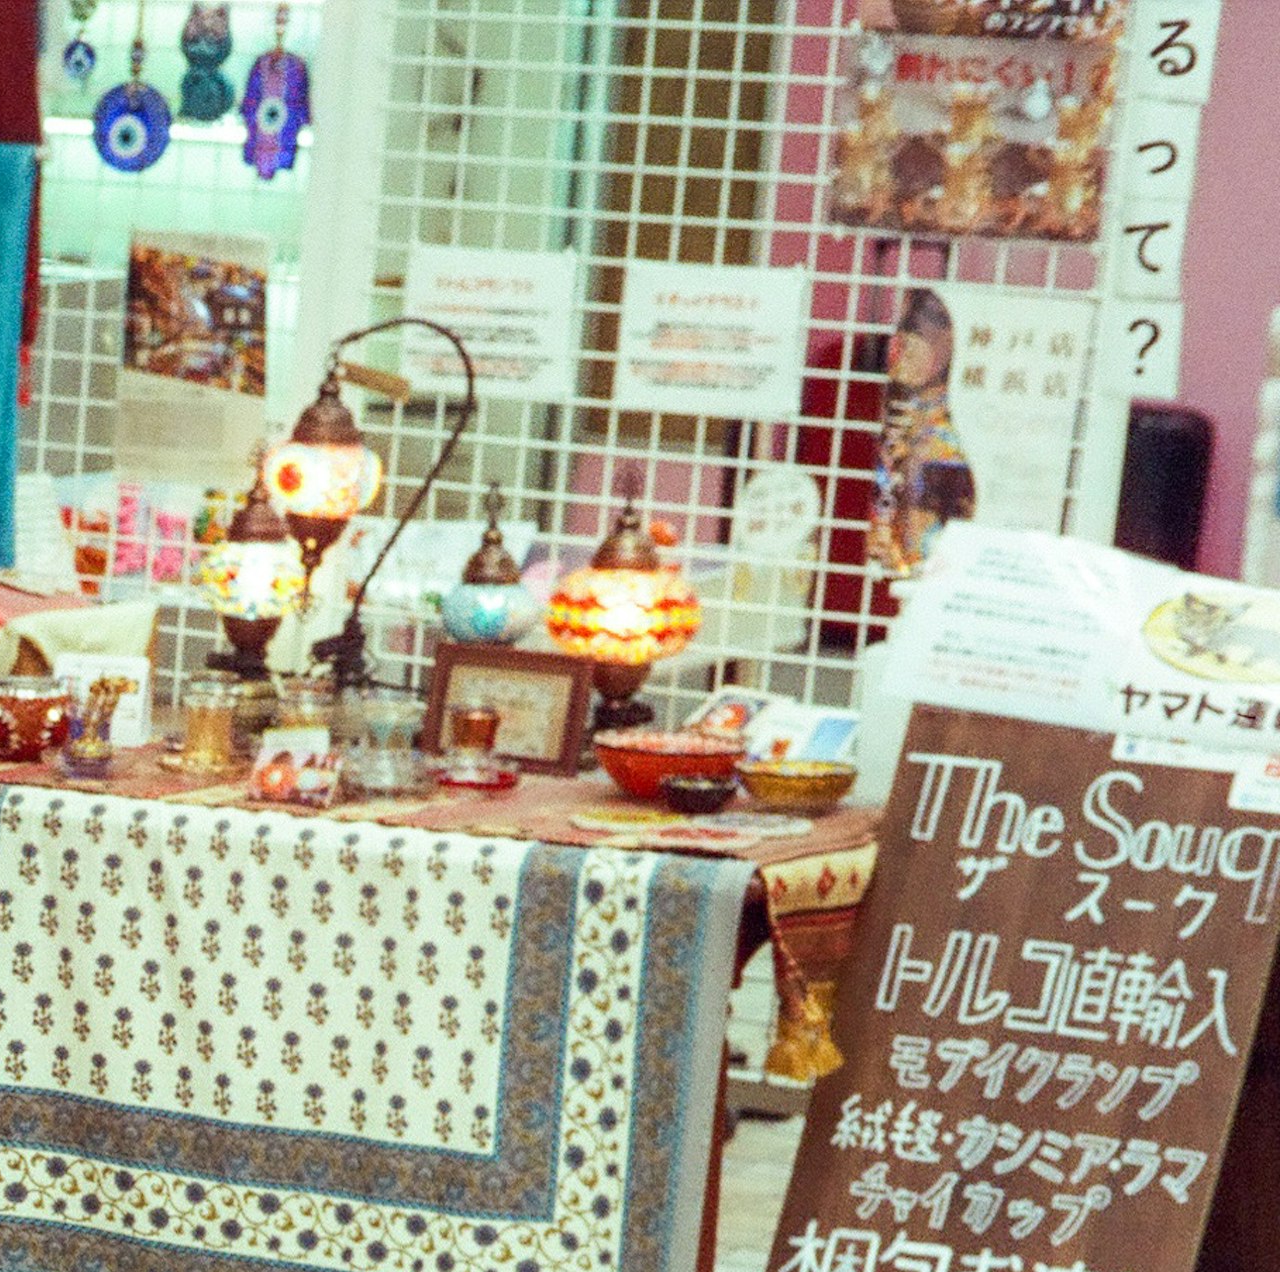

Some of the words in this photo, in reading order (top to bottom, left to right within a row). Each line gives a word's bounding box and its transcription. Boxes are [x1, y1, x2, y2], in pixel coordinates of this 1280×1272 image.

[1119, 684, 1280, 730] ヤマト運
[907, 752, 1065, 858] The
[1074, 770, 1280, 924] Souq
[1064, 872, 1219, 940] スーク
[876, 923, 1238, 1056] トルコ直輸入
[849, 1162, 1113, 1246] チャイカップ
